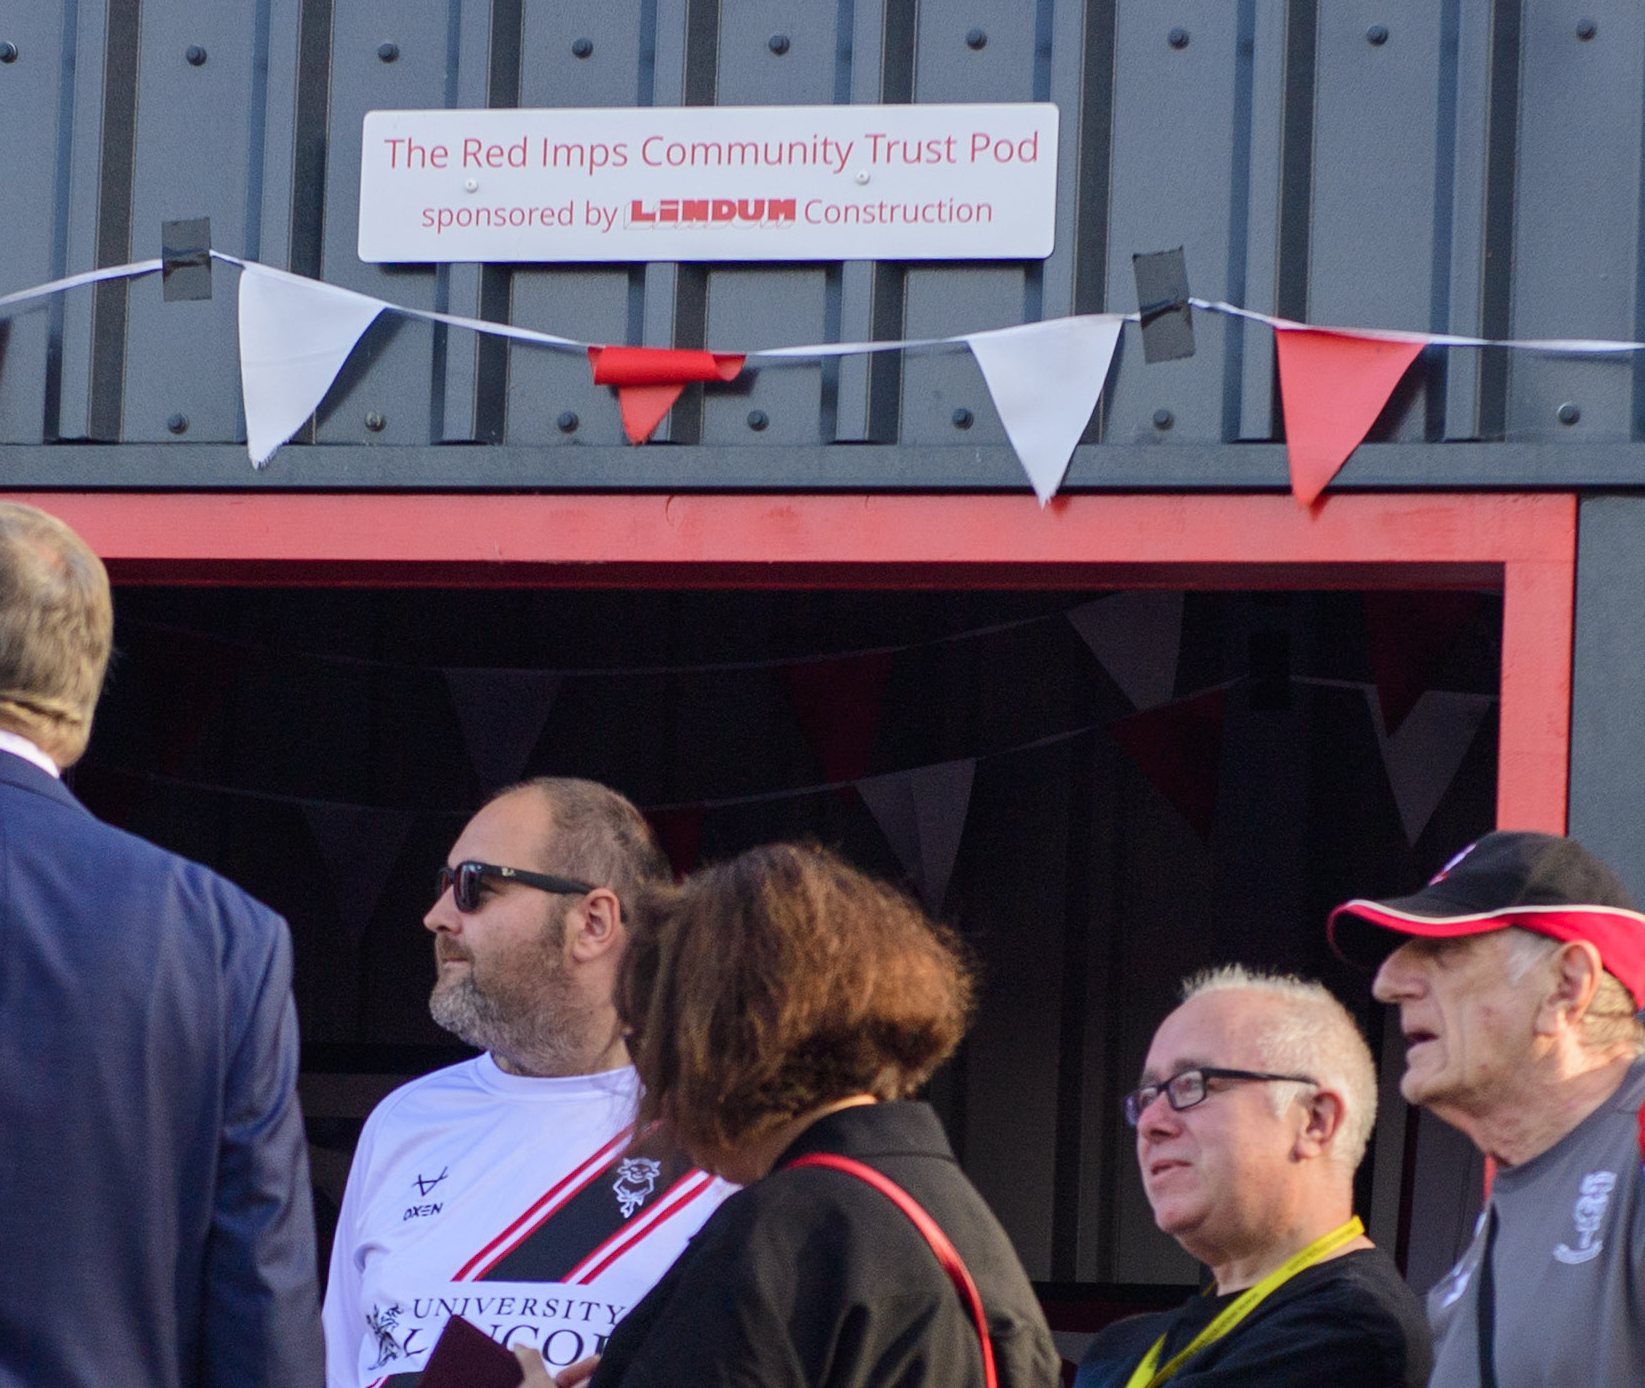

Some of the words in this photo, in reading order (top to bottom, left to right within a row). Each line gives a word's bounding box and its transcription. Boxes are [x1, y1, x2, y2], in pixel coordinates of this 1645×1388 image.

[384, 137, 449, 169] The
[462, 136, 528, 169] Red
[542, 135, 629, 176] Imps
[640, 132, 855, 176] Community
[863, 131, 957, 165] Trust
[970, 130, 1039, 164] Pod
[421, 199, 575, 235] sponsored
[585, 198, 619, 235] by
[804, 195, 993, 227] Construction
[402, 1202, 444, 1222] OXEN
[412, 1297, 627, 1326] UNIVERSITY
